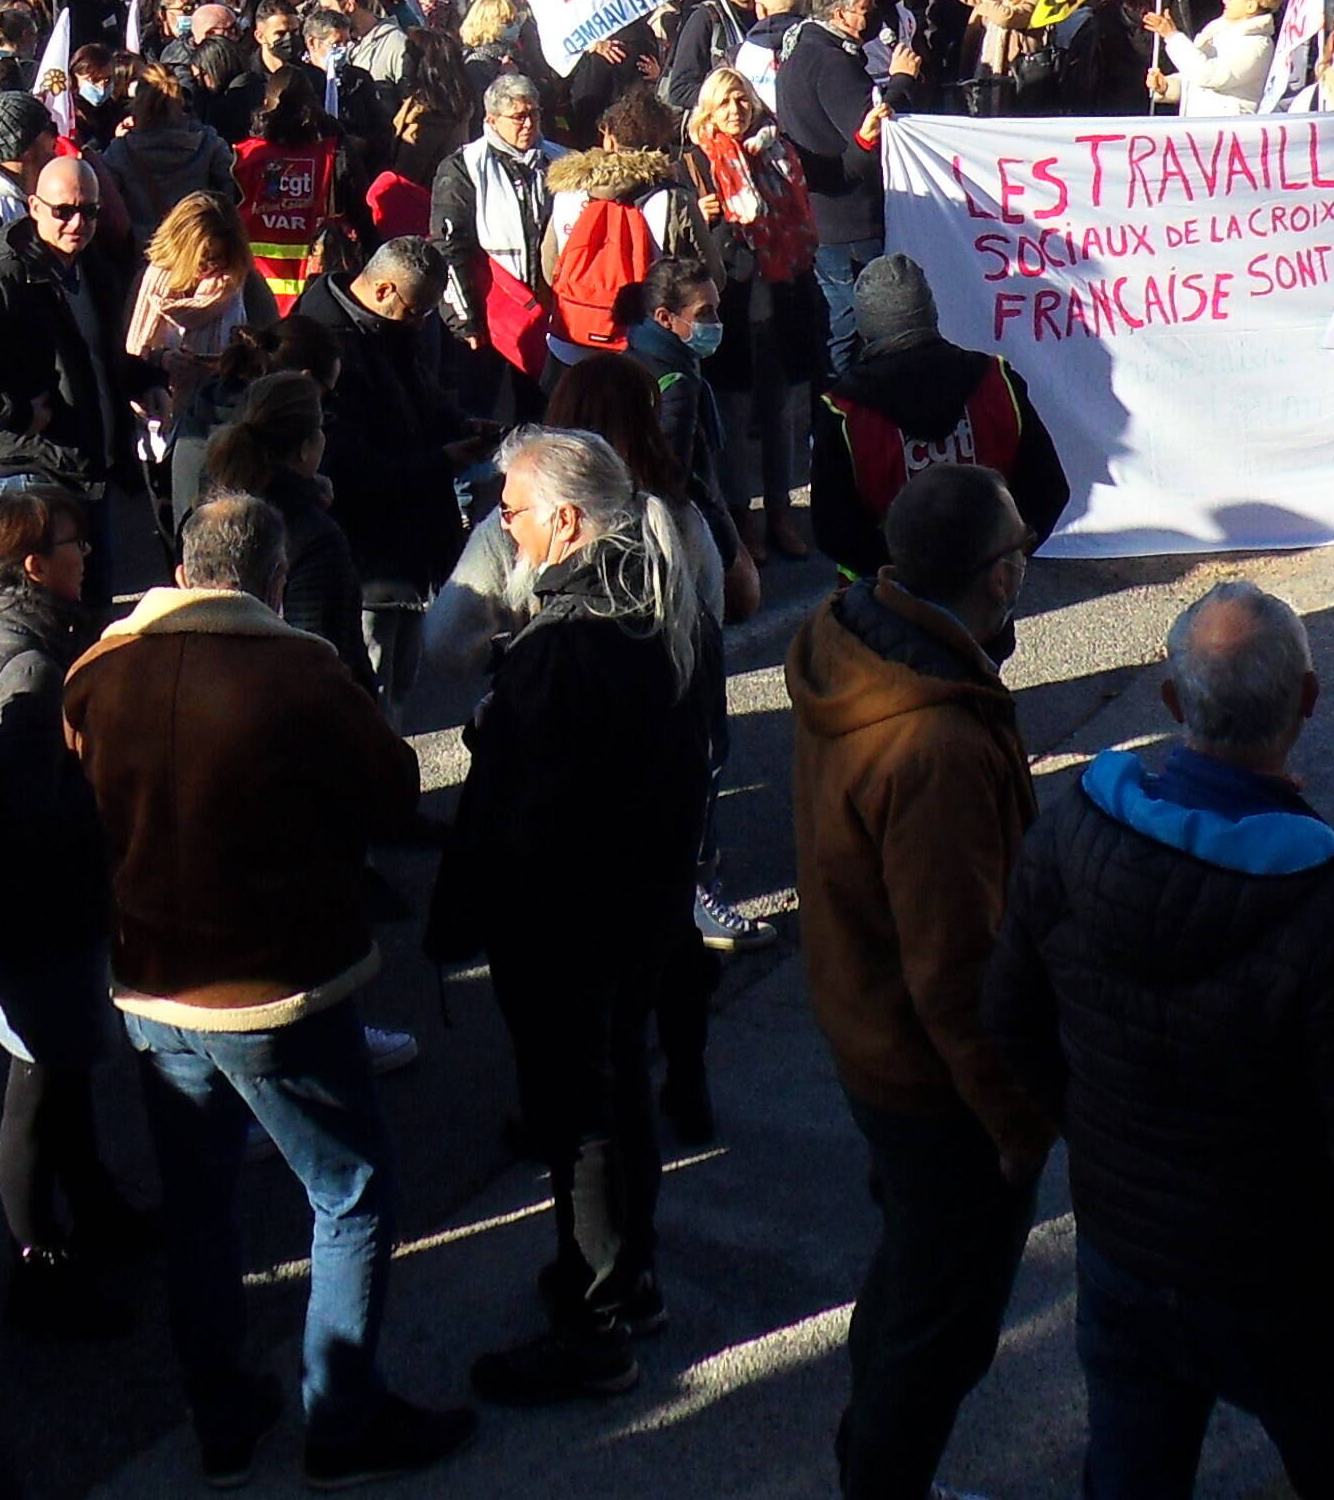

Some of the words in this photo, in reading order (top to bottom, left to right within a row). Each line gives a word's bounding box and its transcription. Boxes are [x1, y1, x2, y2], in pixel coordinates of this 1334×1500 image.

[279, 172, 311, 196] cgt
[953, 155, 1068, 225] LES
[261, 214, 306, 230] VAR
[974, 221, 1155, 282] SOCIAUX
[1167, 219, 1199, 249] DE
[1210, 213, 1243, 244] LA
[994, 266, 1234, 343] FRANÇAISE
[1248, 245, 1332, 297] SONT
[904, 418, 975, 472] ct
